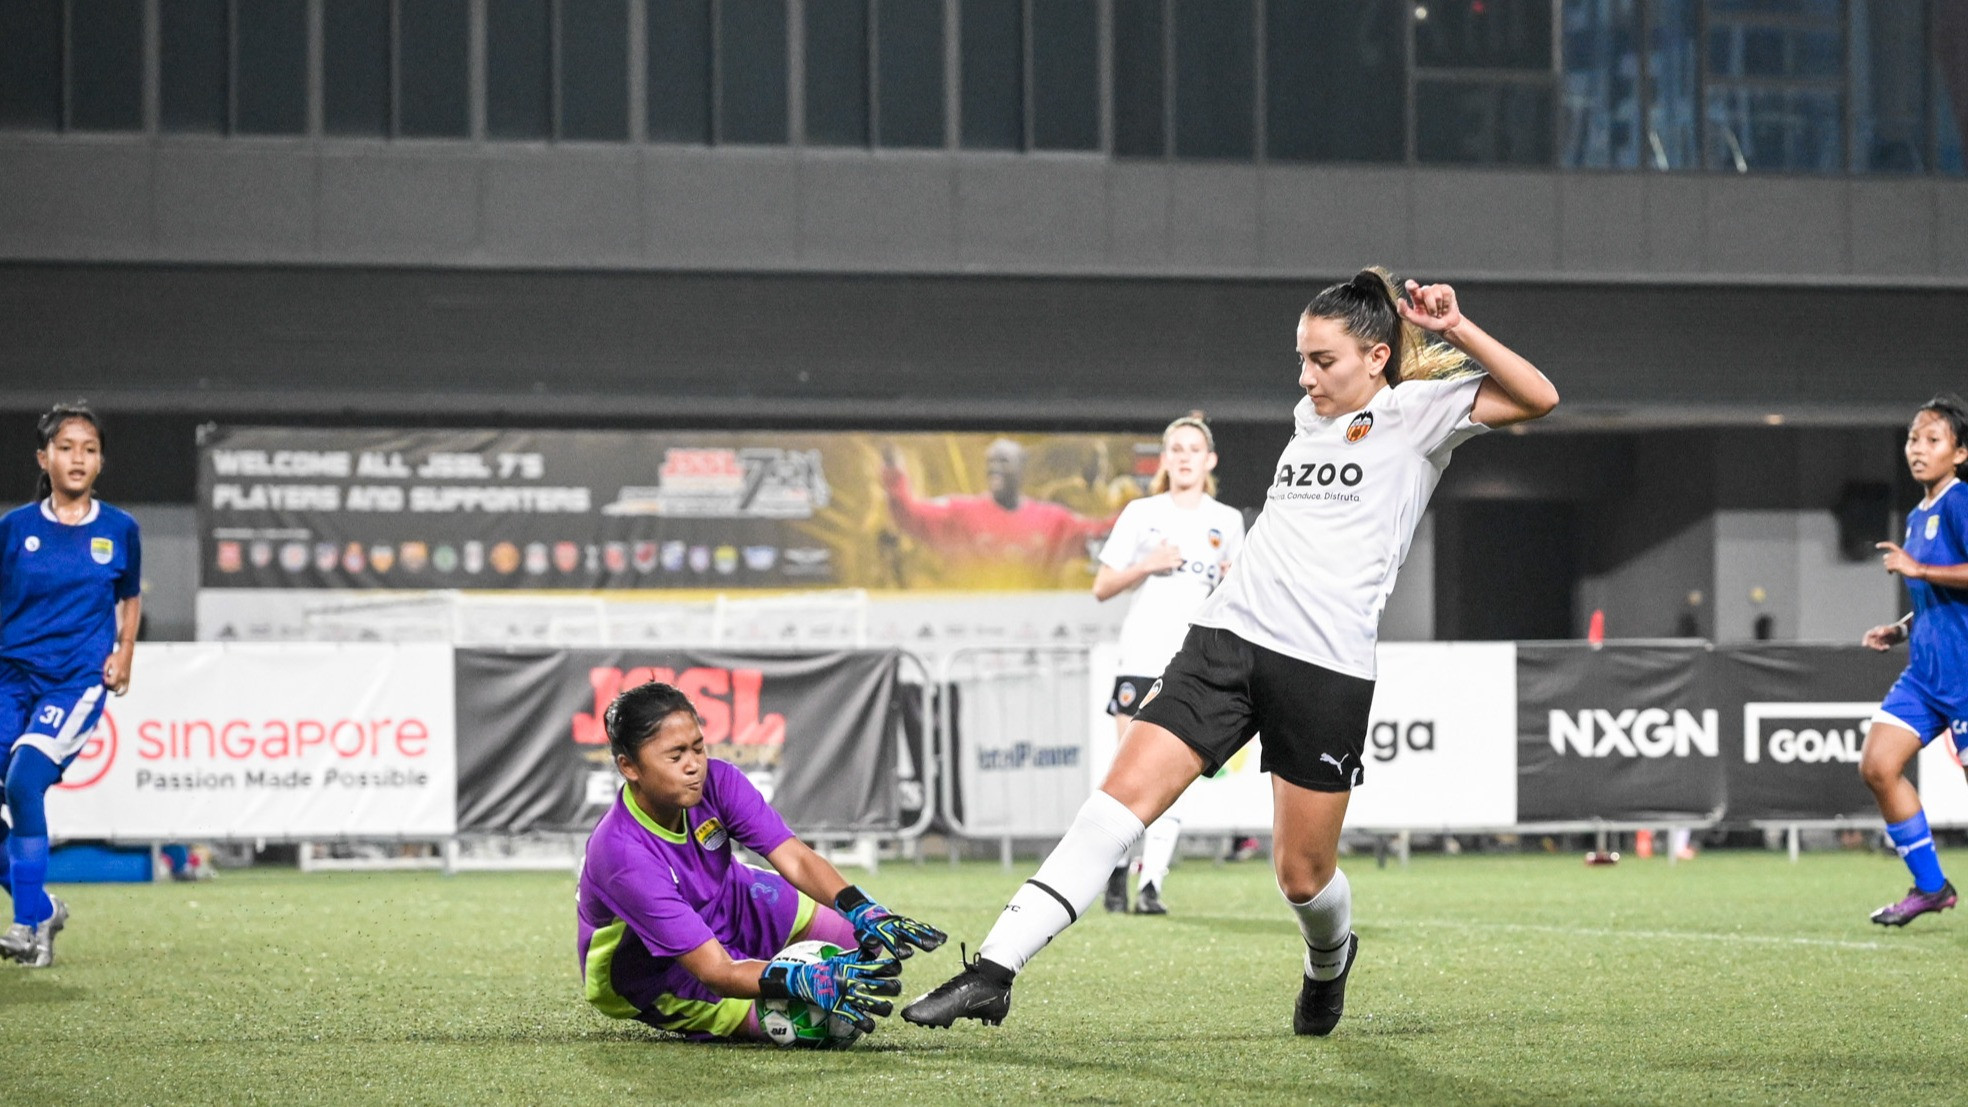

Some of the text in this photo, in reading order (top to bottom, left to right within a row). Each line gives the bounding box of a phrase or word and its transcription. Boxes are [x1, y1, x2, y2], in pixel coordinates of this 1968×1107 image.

[213, 451, 350, 477] WELCOME
[357, 452, 412, 478] ALL
[1275, 463, 1363, 487] AZOO
[213, 484, 340, 511] PLAYERS
[346, 485, 404, 512] AND
[410, 486, 590, 512] SUPPORTERS
[39, 705, 65, 729] 31
[571, 667, 786, 744] JSL
[1371, 720, 1435, 762] ga
[1548, 708, 1719, 758] NXGN
[1769, 729, 1862, 763] GOAL
[136, 767, 428, 790] Passion Made Possible
